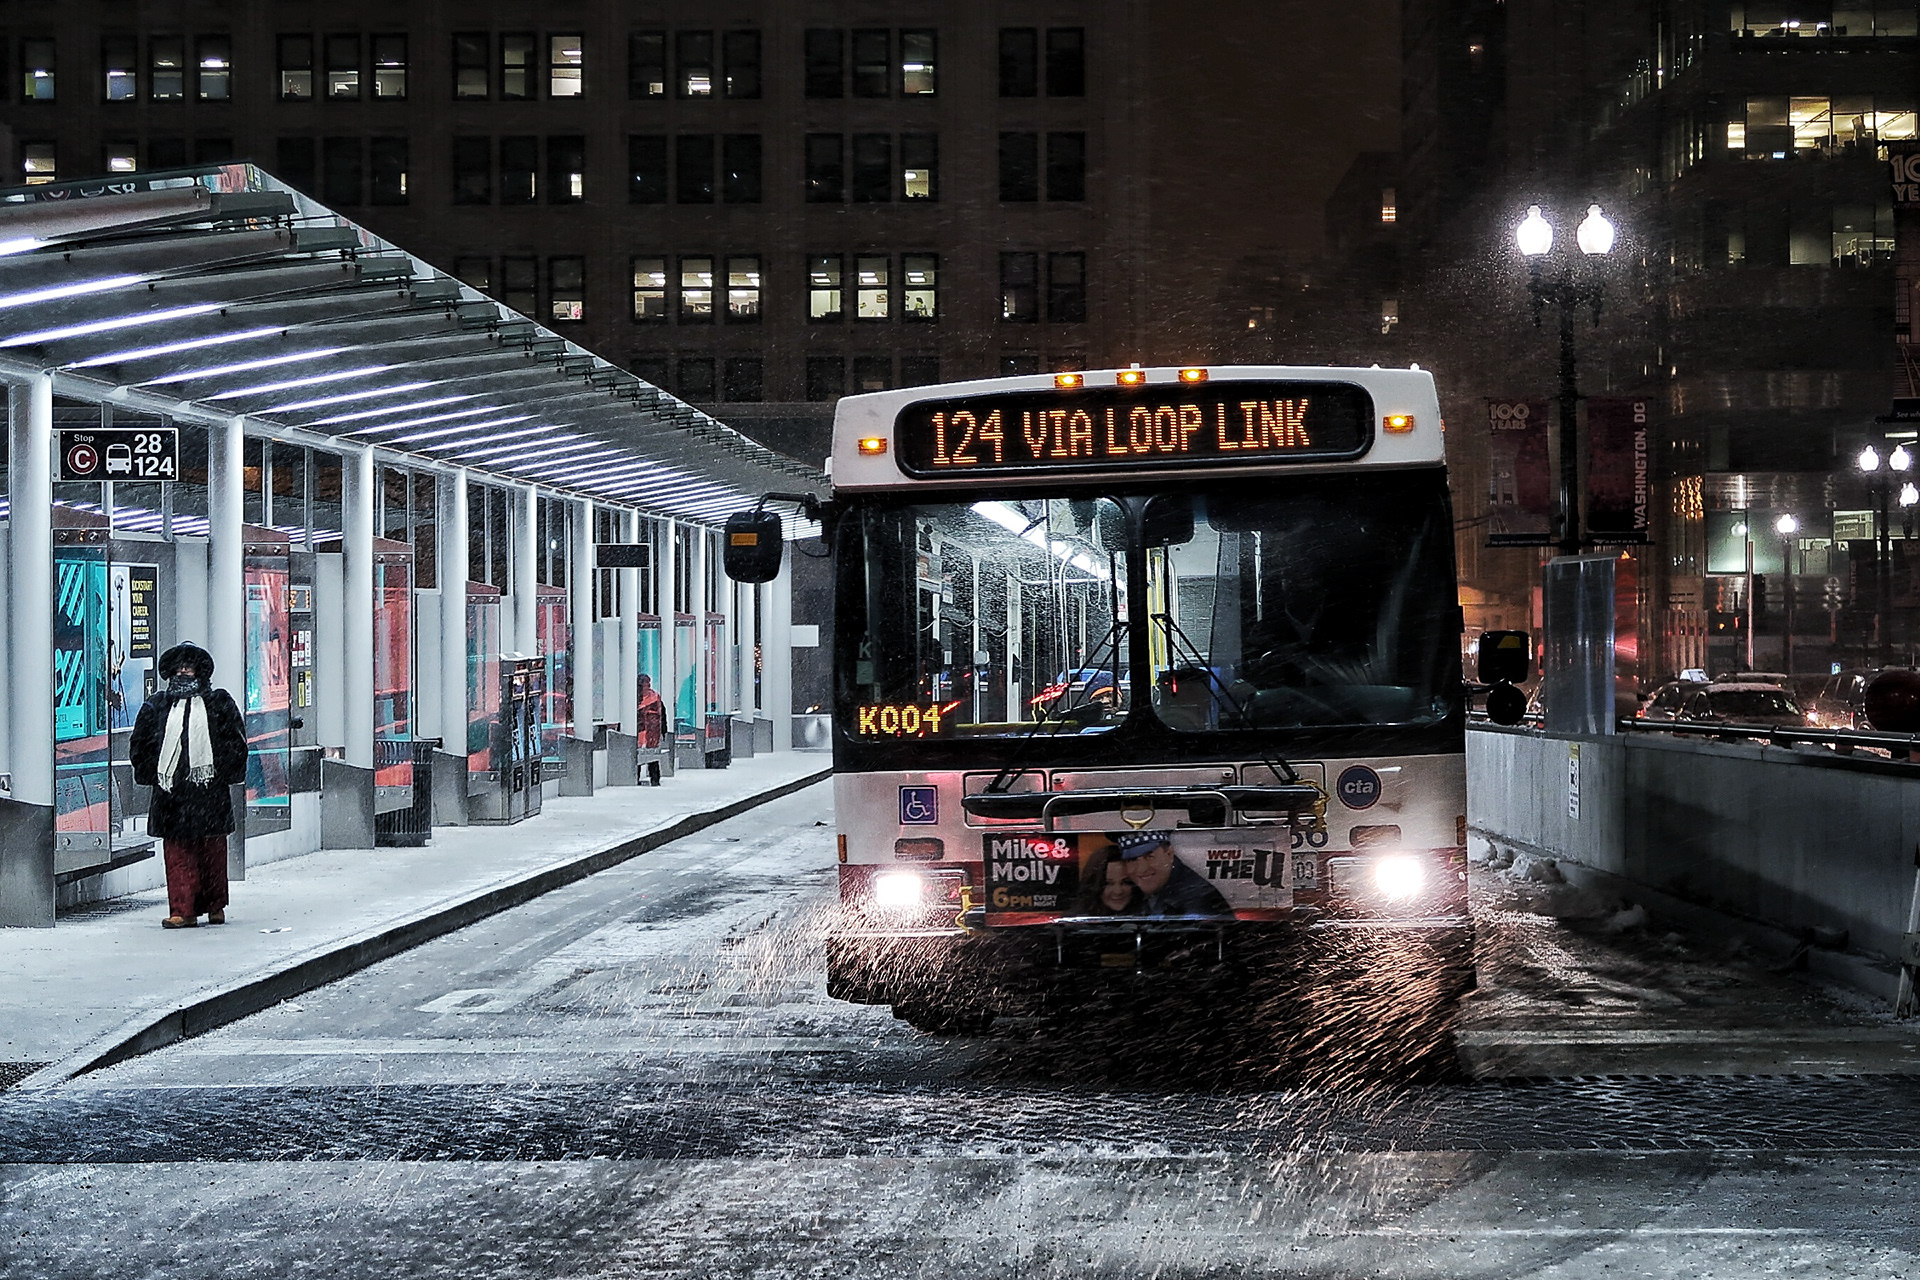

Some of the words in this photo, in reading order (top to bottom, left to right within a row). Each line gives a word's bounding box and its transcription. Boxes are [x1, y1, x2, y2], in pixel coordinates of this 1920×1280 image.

[1490, 403, 1530, 420] 100
[1633, 402, 1646, 423] DC
[932, 410, 1003, 464] 124
[1023, 409, 1092, 458] VIA
[1106, 405, 1202, 454] LOOP
[1217, 399, 1310, 449] LINK
[1490, 419, 1527, 430] YEARS
[74, 434, 94, 443] Stop
[134, 434, 162, 453] 28
[75, 450, 91, 469] C
[134, 457, 174, 476] 124
[1634, 427, 1648, 530] WASHINGTON,
[860, 705, 941, 734] K004
[1344, 780, 1374, 793] cta
[1208, 850, 1241, 860] WCIU
[992, 860, 1060, 885] Molly
[1206, 860, 1254, 879] THE
[993, 887, 1033, 908] 6PM
